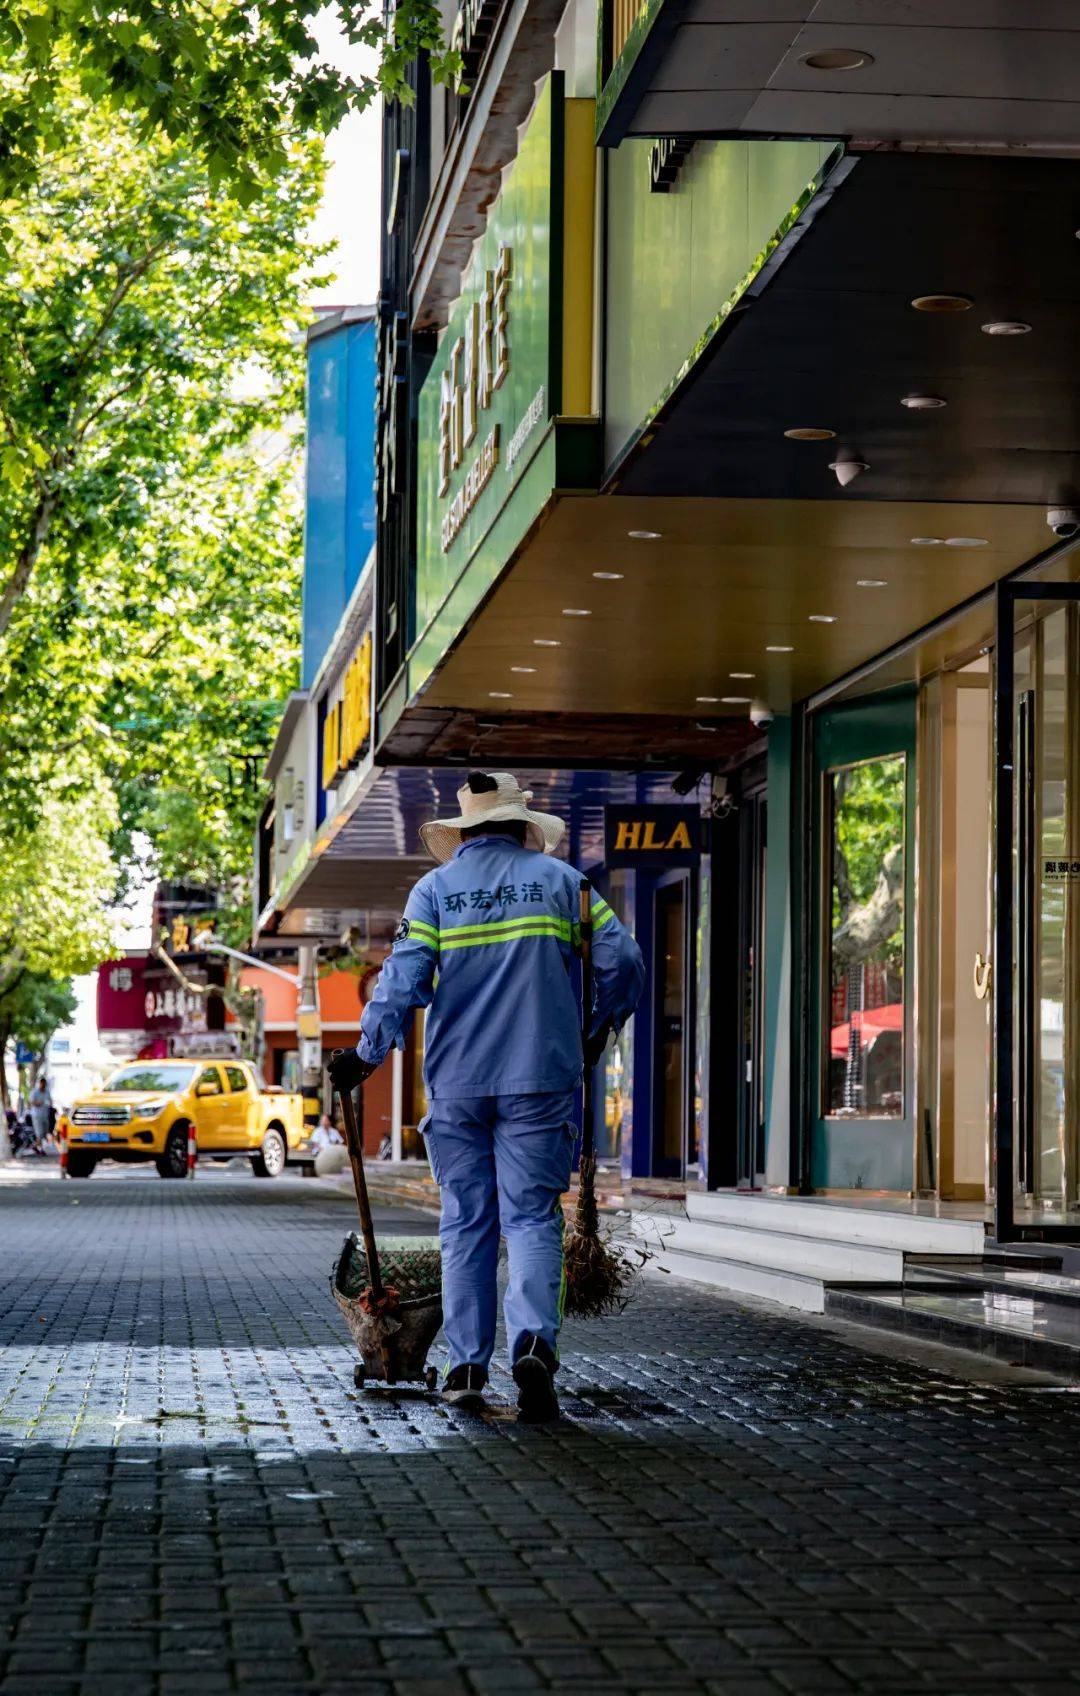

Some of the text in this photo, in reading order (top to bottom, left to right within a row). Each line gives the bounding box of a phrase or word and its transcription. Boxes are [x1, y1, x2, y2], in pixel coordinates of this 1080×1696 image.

[614, 821, 692, 850] HLA
[444, 881, 544, 914] 环宏保洁
